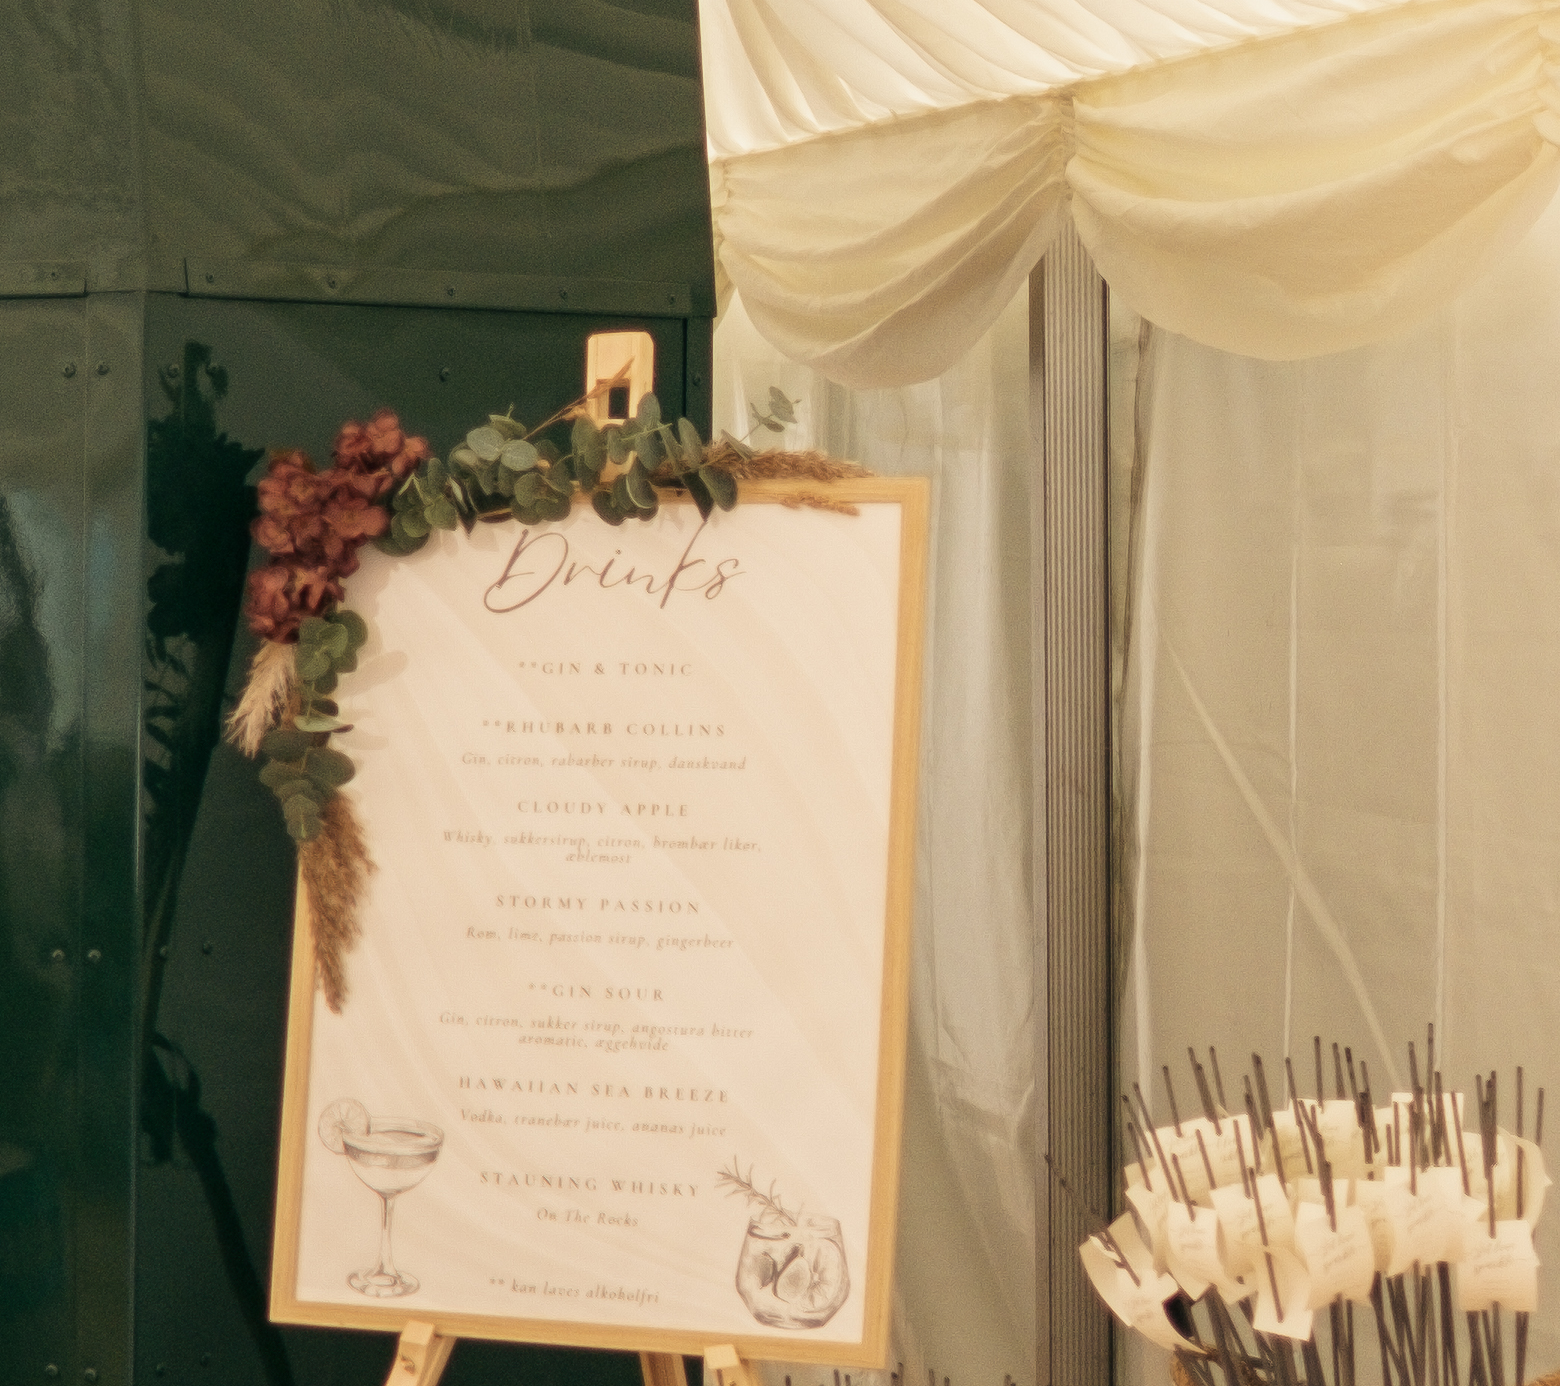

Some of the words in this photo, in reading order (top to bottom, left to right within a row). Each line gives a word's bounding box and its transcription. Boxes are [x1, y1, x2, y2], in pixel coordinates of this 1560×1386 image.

[482, 516, 745, 614] Drinks
[592, 662, 606, 675] &
[618, 662, 694, 676] TONIC
[624, 723, 726, 737] COLLINS
[515, 800, 605, 815] CLOUDY
[621, 803, 688, 817] APPLE
[495, 894, 585, 910] STORMY
[599, 898, 700, 914] PASSION
[604, 987, 665, 1002] SOUR
[458, 1076, 579, 1094] HAWAIIAN
[591, 1083, 631, 1098] SEA
[643, 1086, 728, 1103] BREEZE
[479, 1171, 598, 1191] STAUNING
[610, 1179, 697, 1197] WHISKY
[535, 1207, 558, 1221] On
[564, 1209, 591, 1224] The
[595, 1211, 639, 1227] Rocks
